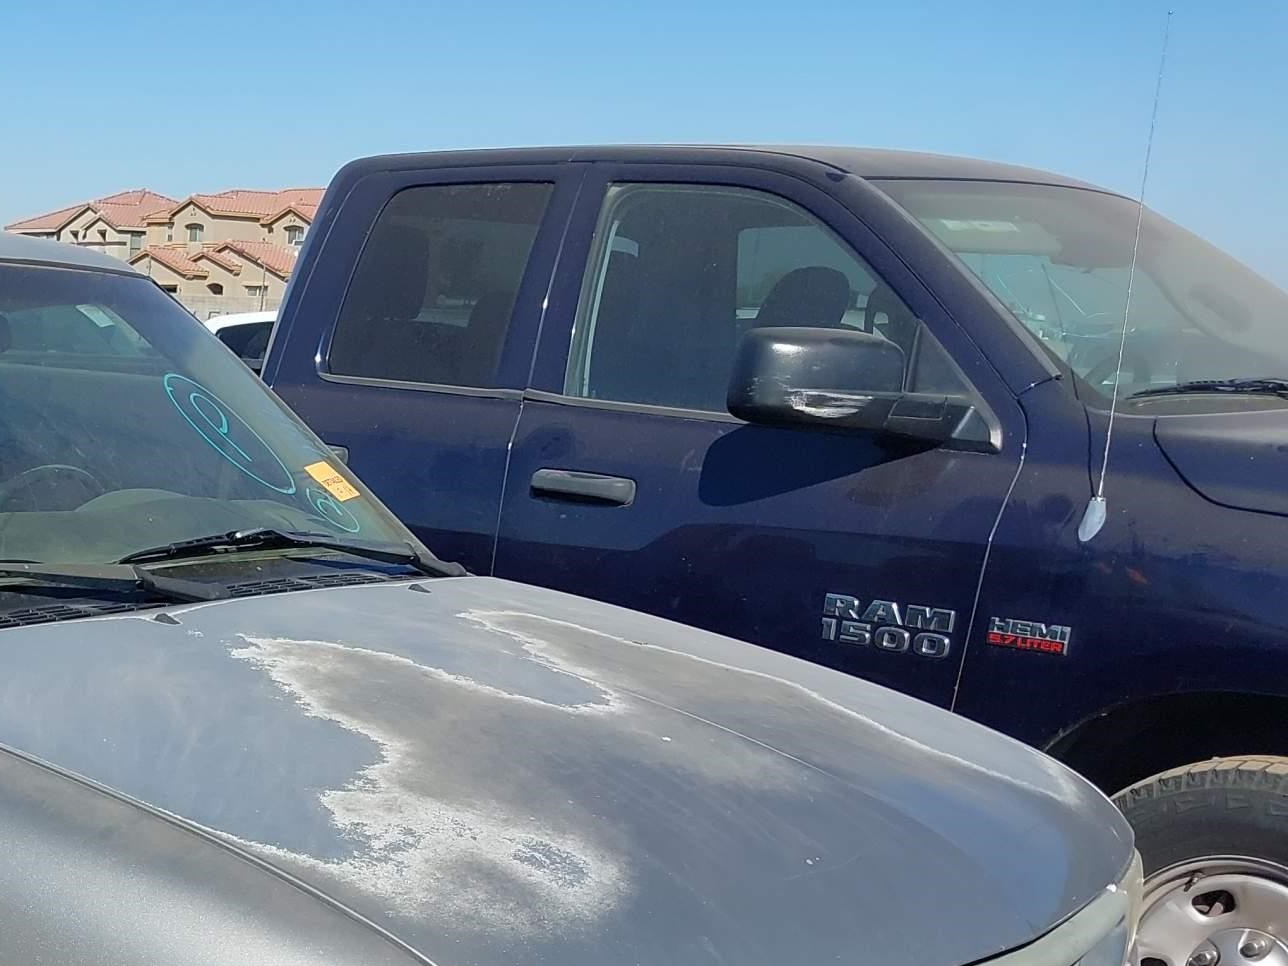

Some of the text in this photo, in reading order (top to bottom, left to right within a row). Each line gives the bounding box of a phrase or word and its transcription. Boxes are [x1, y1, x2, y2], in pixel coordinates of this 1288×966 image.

[824, 592, 956, 634] RAM
[821, 617, 952, 658] 1500
[989, 616, 1072, 656] HEMI
[1016, 636, 1063, 653] LITER
